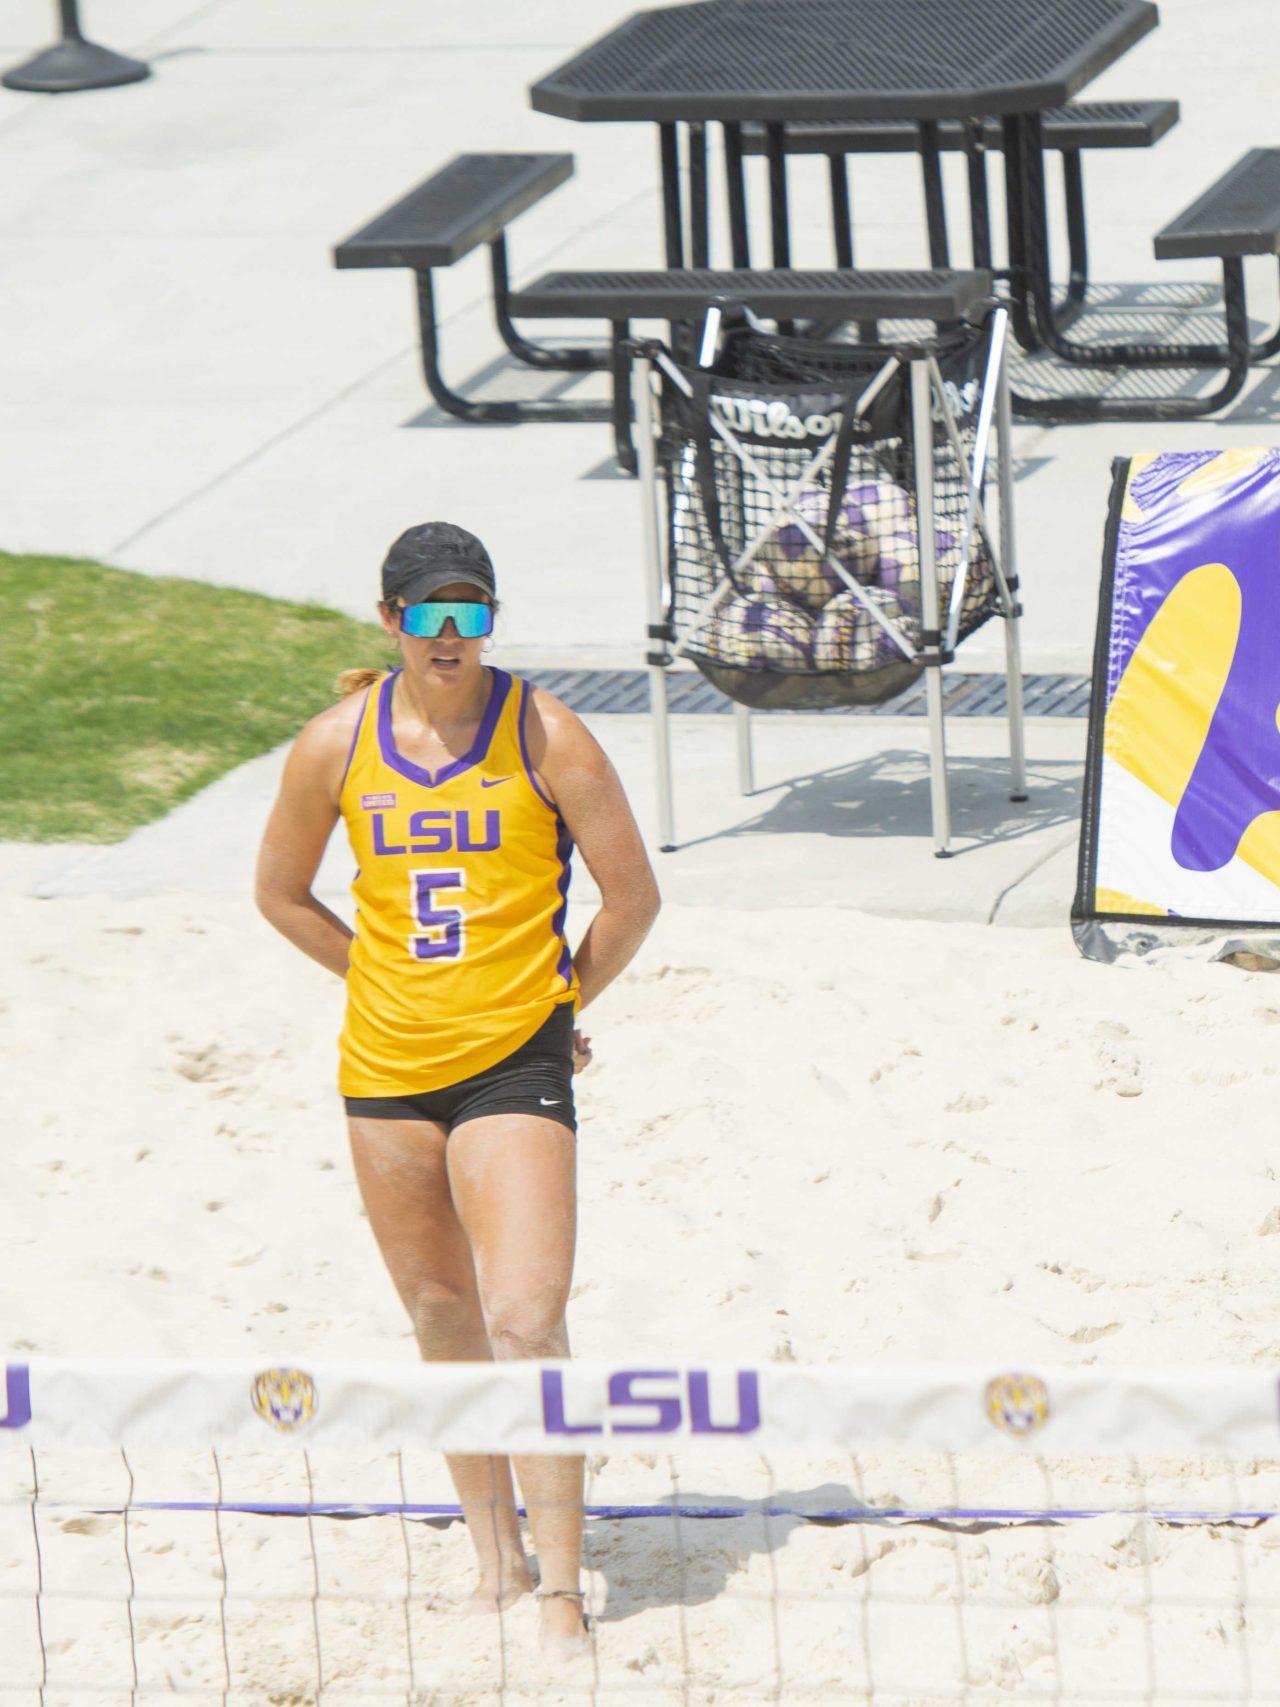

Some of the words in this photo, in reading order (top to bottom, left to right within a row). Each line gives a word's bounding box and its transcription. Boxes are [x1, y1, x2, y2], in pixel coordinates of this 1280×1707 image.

[372, 810, 501, 856] LSU
[408, 868, 467, 962] 5
[541, 1368, 762, 1435] LSU
